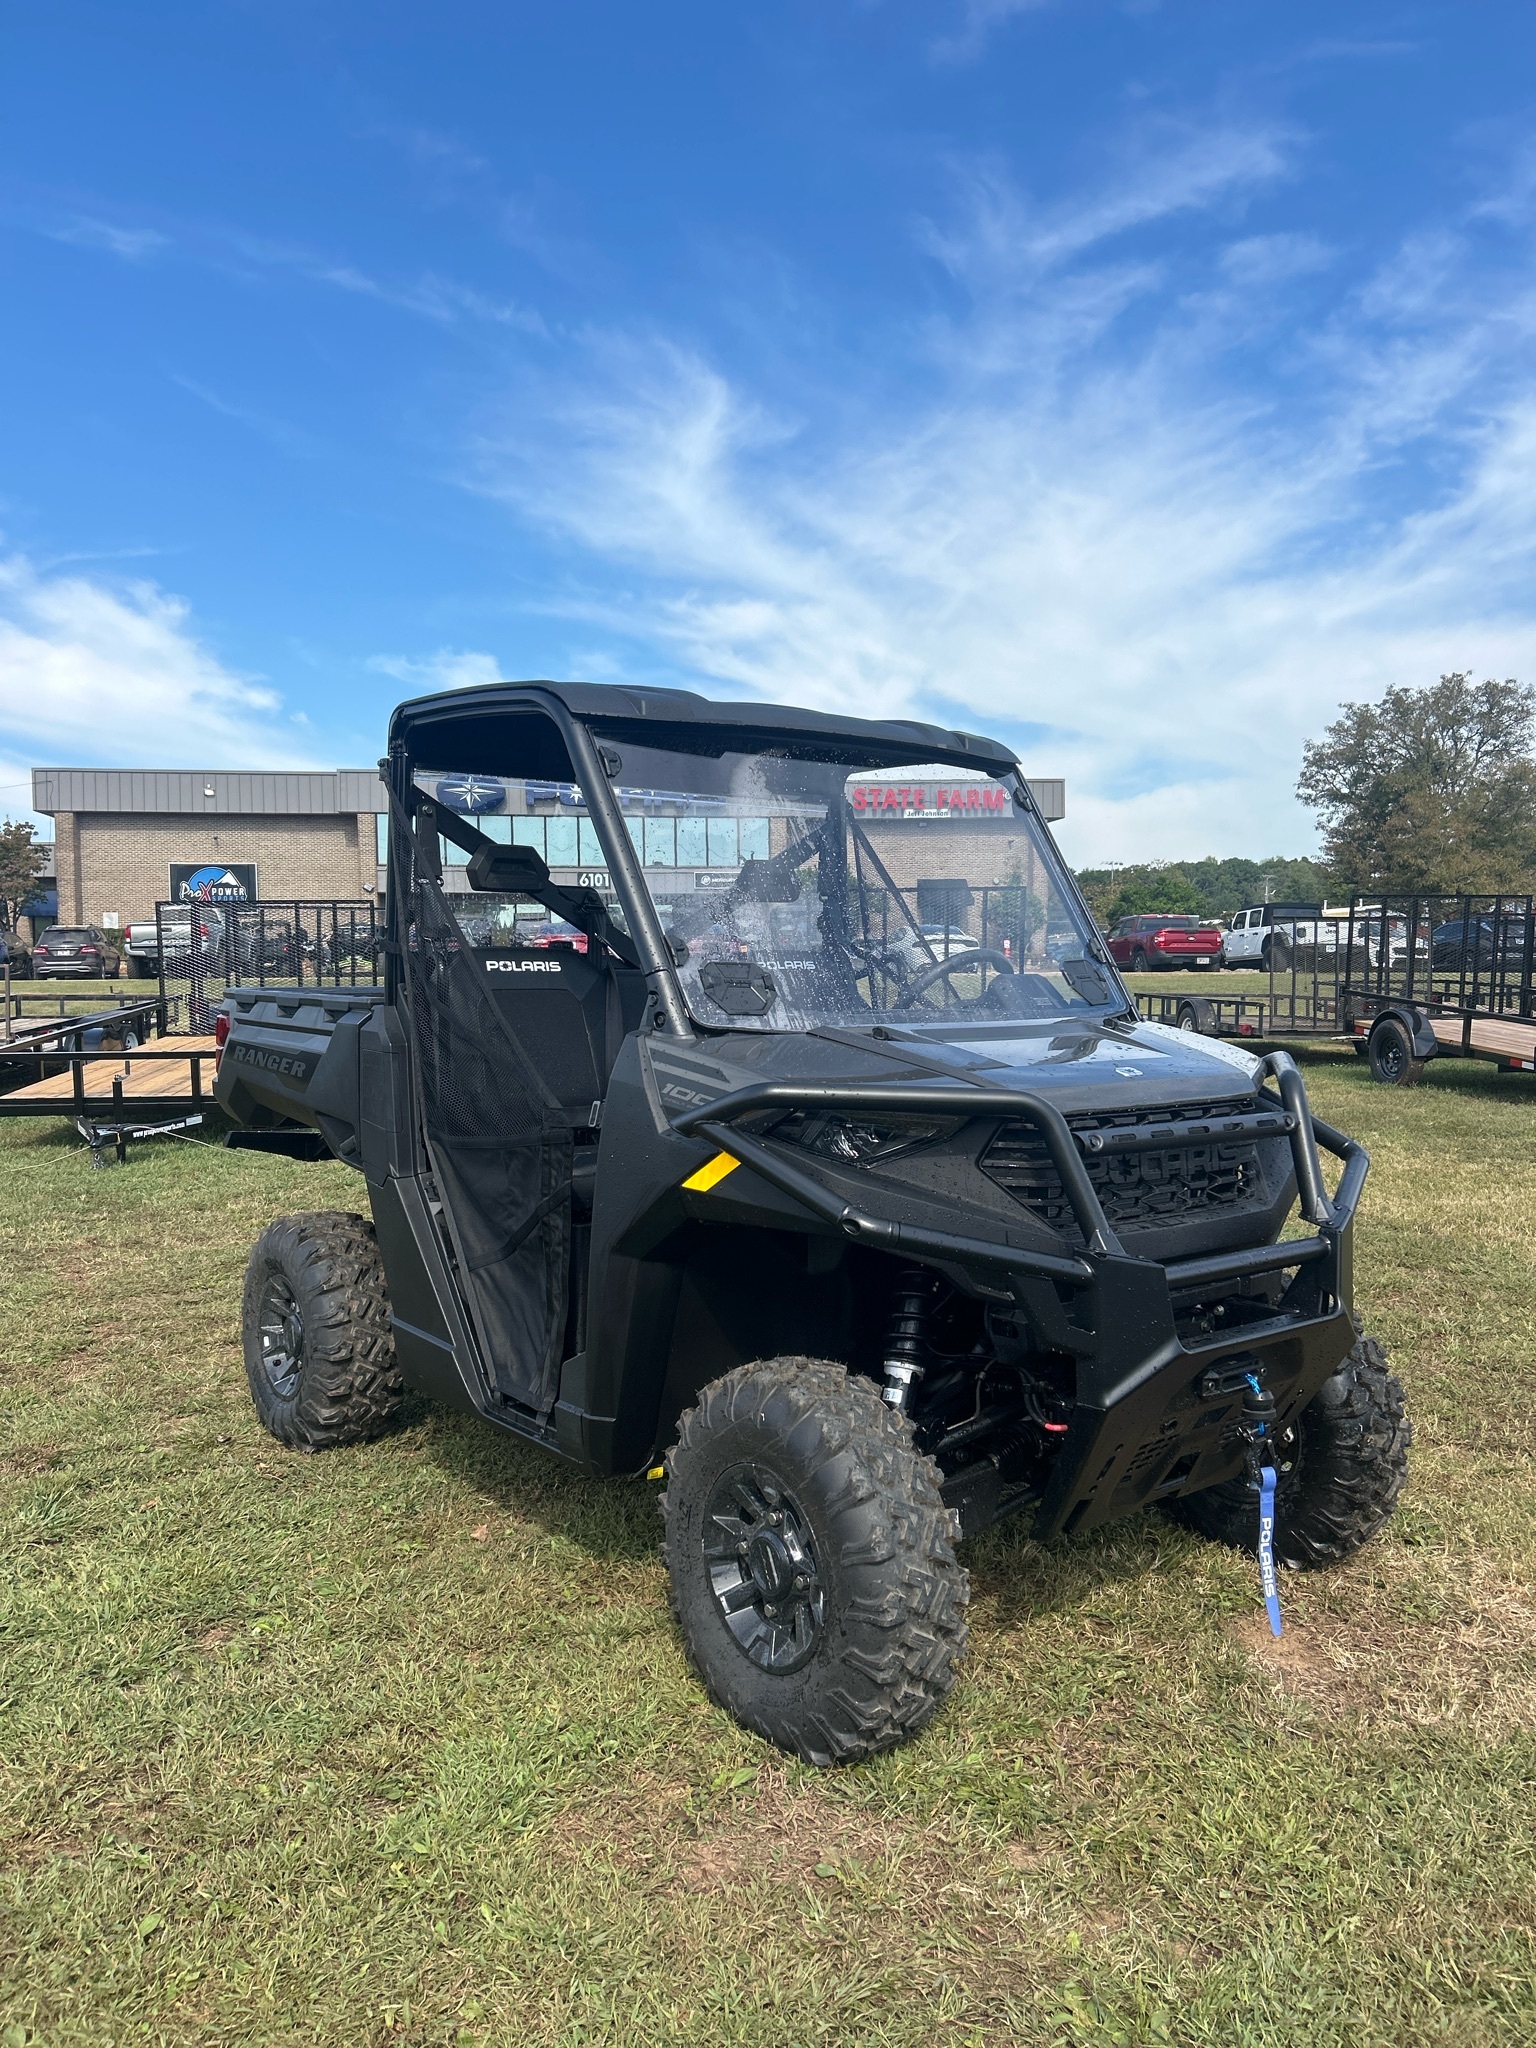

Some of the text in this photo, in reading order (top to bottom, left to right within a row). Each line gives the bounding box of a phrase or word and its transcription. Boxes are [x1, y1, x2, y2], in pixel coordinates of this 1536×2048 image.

[853, 787, 1004, 810] STATE FARM
[579, 873, 609, 887] 6101
[211, 887, 245, 896] POWER
[485, 960, 562, 972] POLARIS
[233, 1045, 307, 1078] RANGER
[1260, 1517, 1275, 1598] POLARIS
